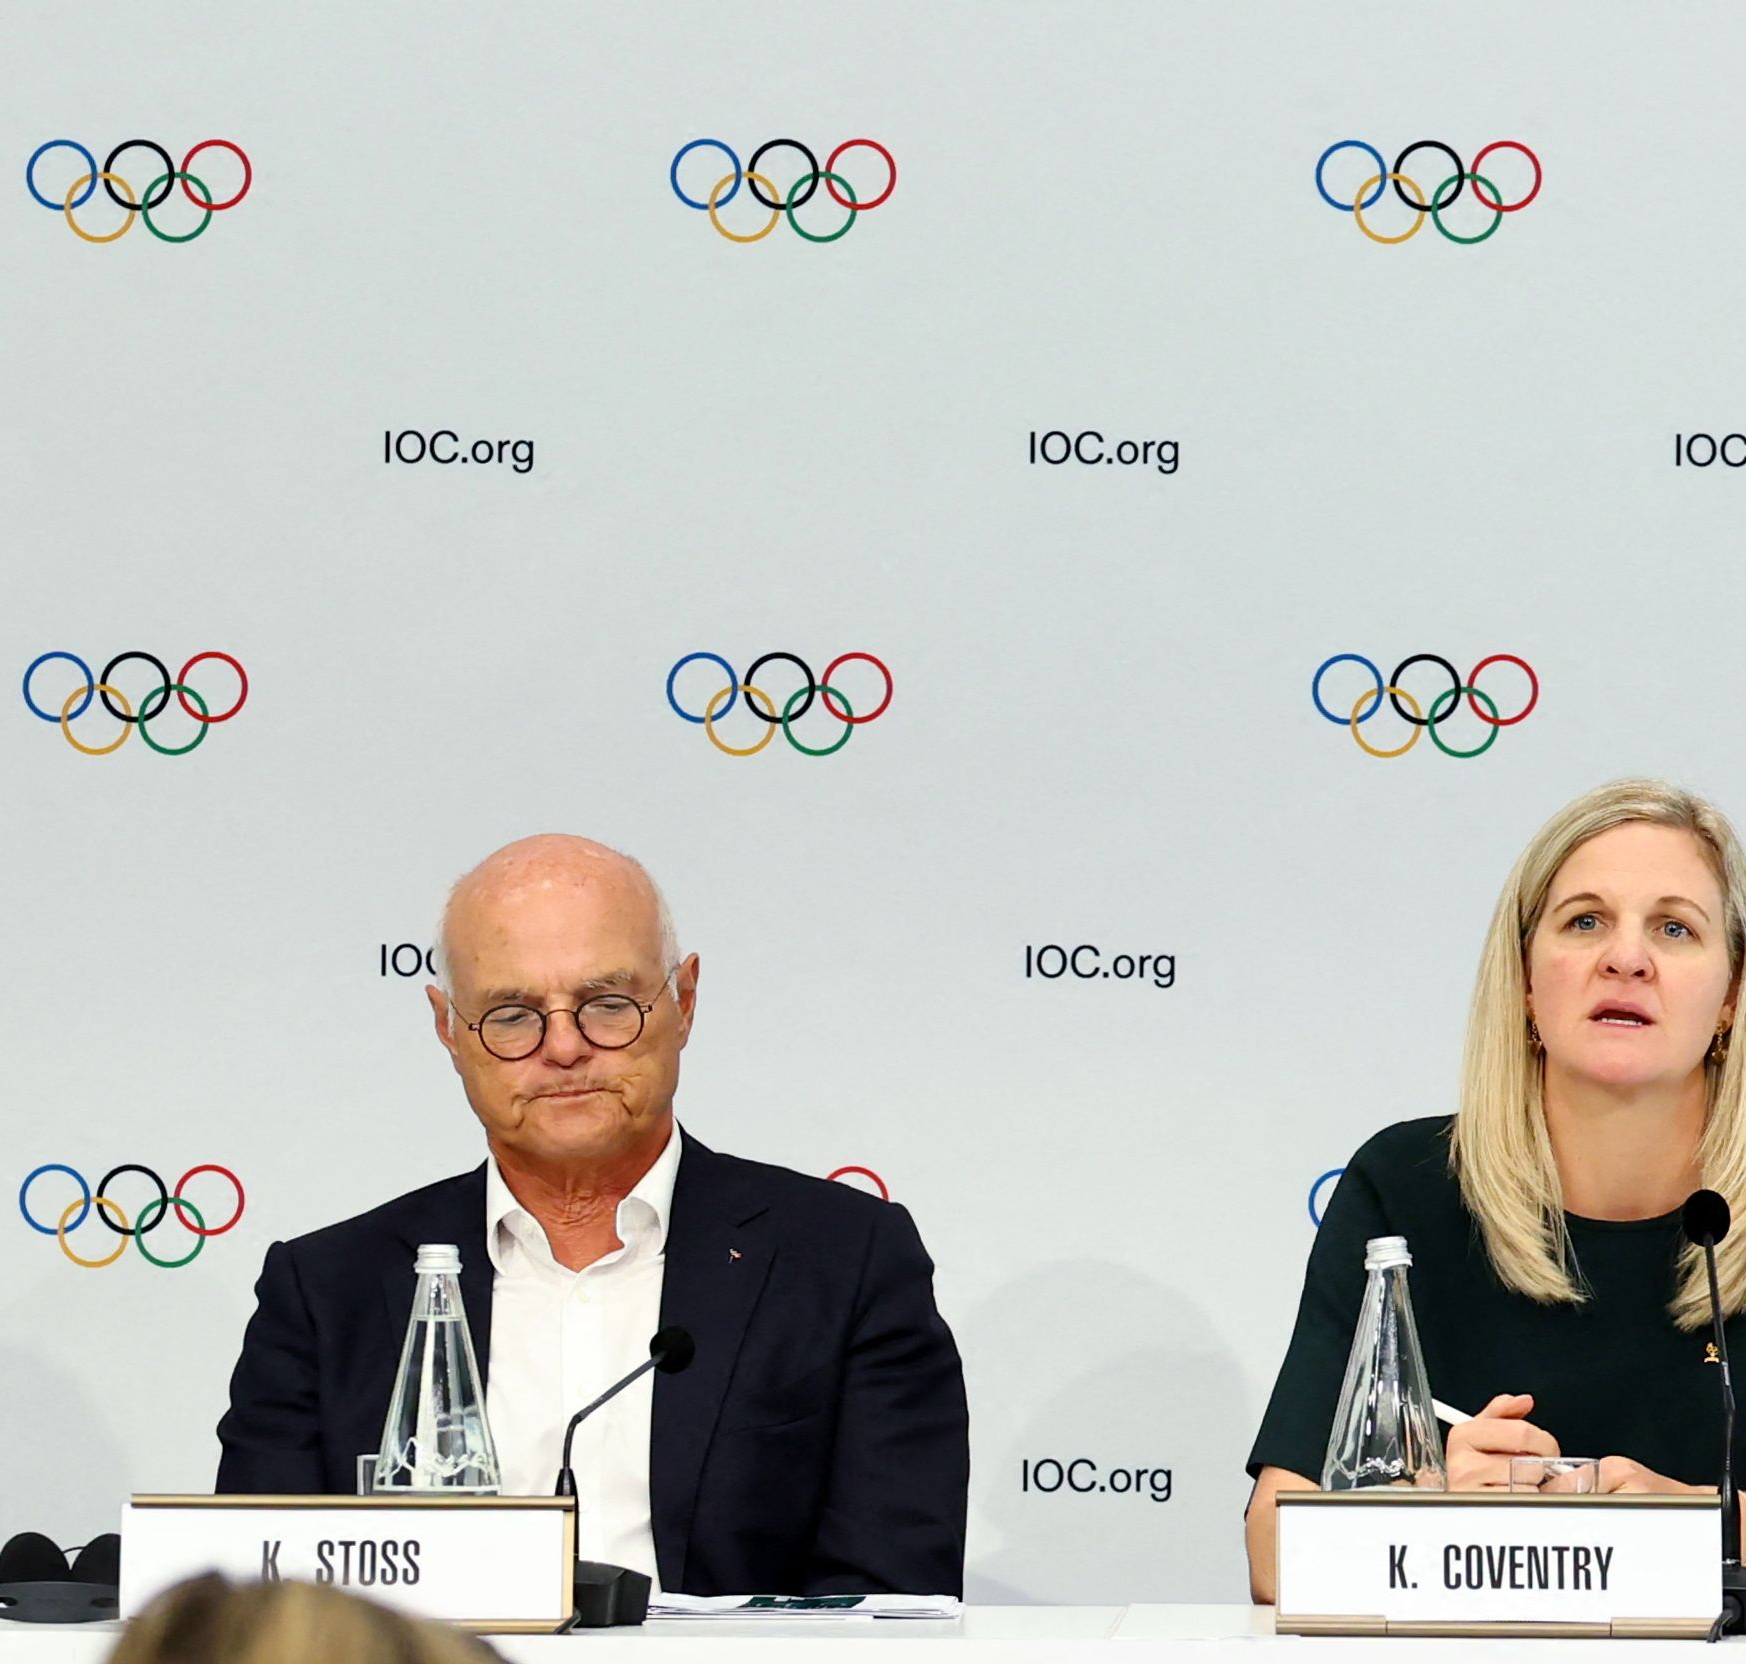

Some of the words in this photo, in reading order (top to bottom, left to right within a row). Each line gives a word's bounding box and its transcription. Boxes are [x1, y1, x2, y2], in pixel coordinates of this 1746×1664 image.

[384, 429, 533, 473] IOC.org
[1029, 430, 1178, 474] IOC.org
[1025, 944, 1175, 988] IOC.org
[1022, 1458, 1172, 1502] IOC.org
[315, 1539, 421, 1586] STOSS
[1389, 1544, 1418, 1589] K.
[1443, 1544, 1614, 1590] COVENTRY
